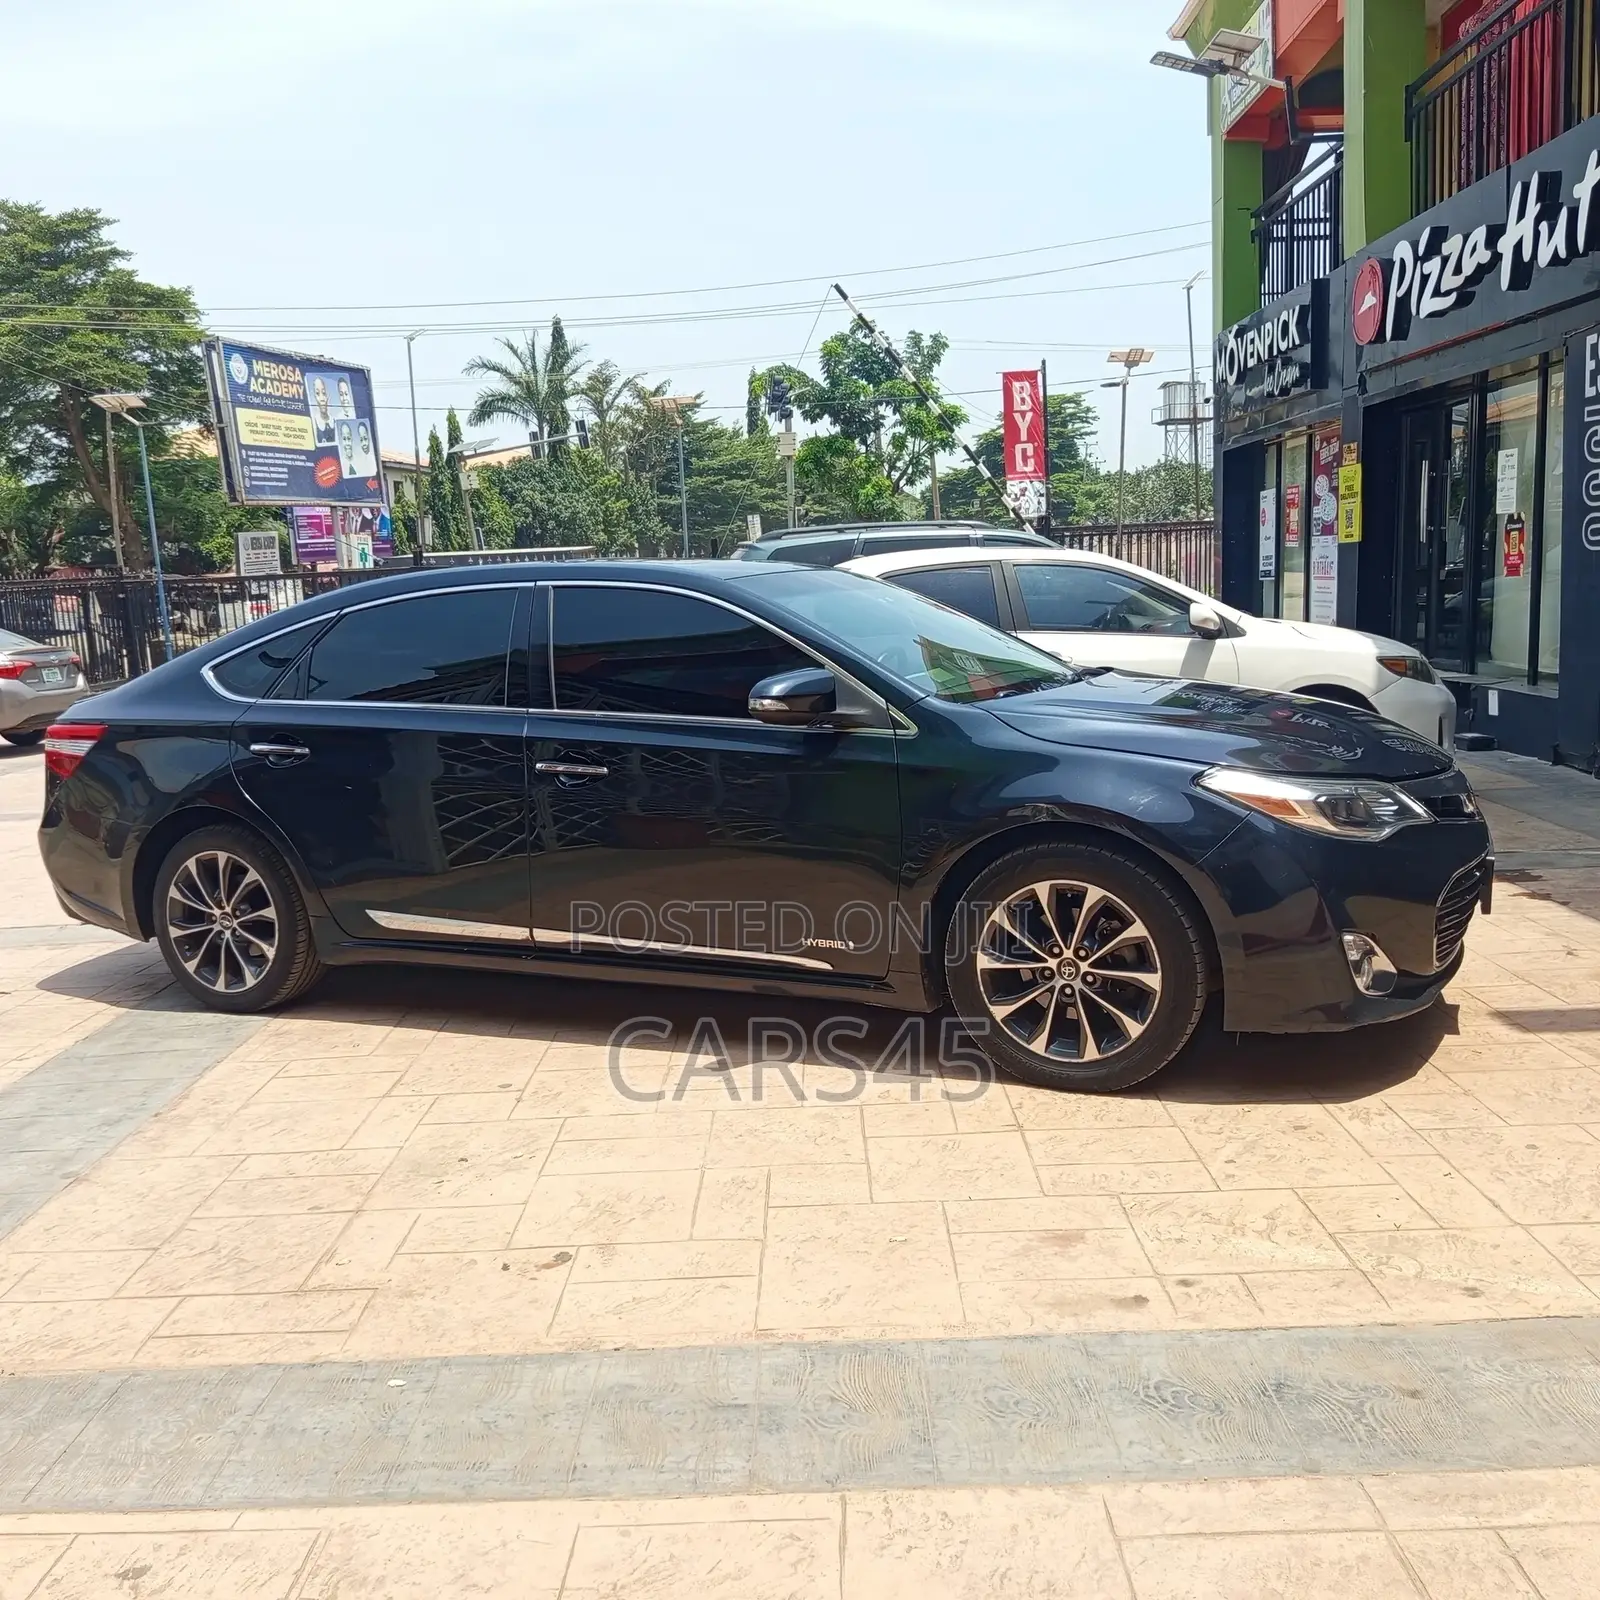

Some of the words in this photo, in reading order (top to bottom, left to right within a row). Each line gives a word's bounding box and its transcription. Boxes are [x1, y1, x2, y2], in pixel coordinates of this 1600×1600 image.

[1386, 224, 1491, 342] Pizza
[1497, 149, 1600, 291] Hut
[252, 359, 303, 384] MEROSA
[250, 376, 304, 400] ACADEMY
[1012, 381, 1035, 472] BYC
[801, 937, 846, 949] HYBRID
